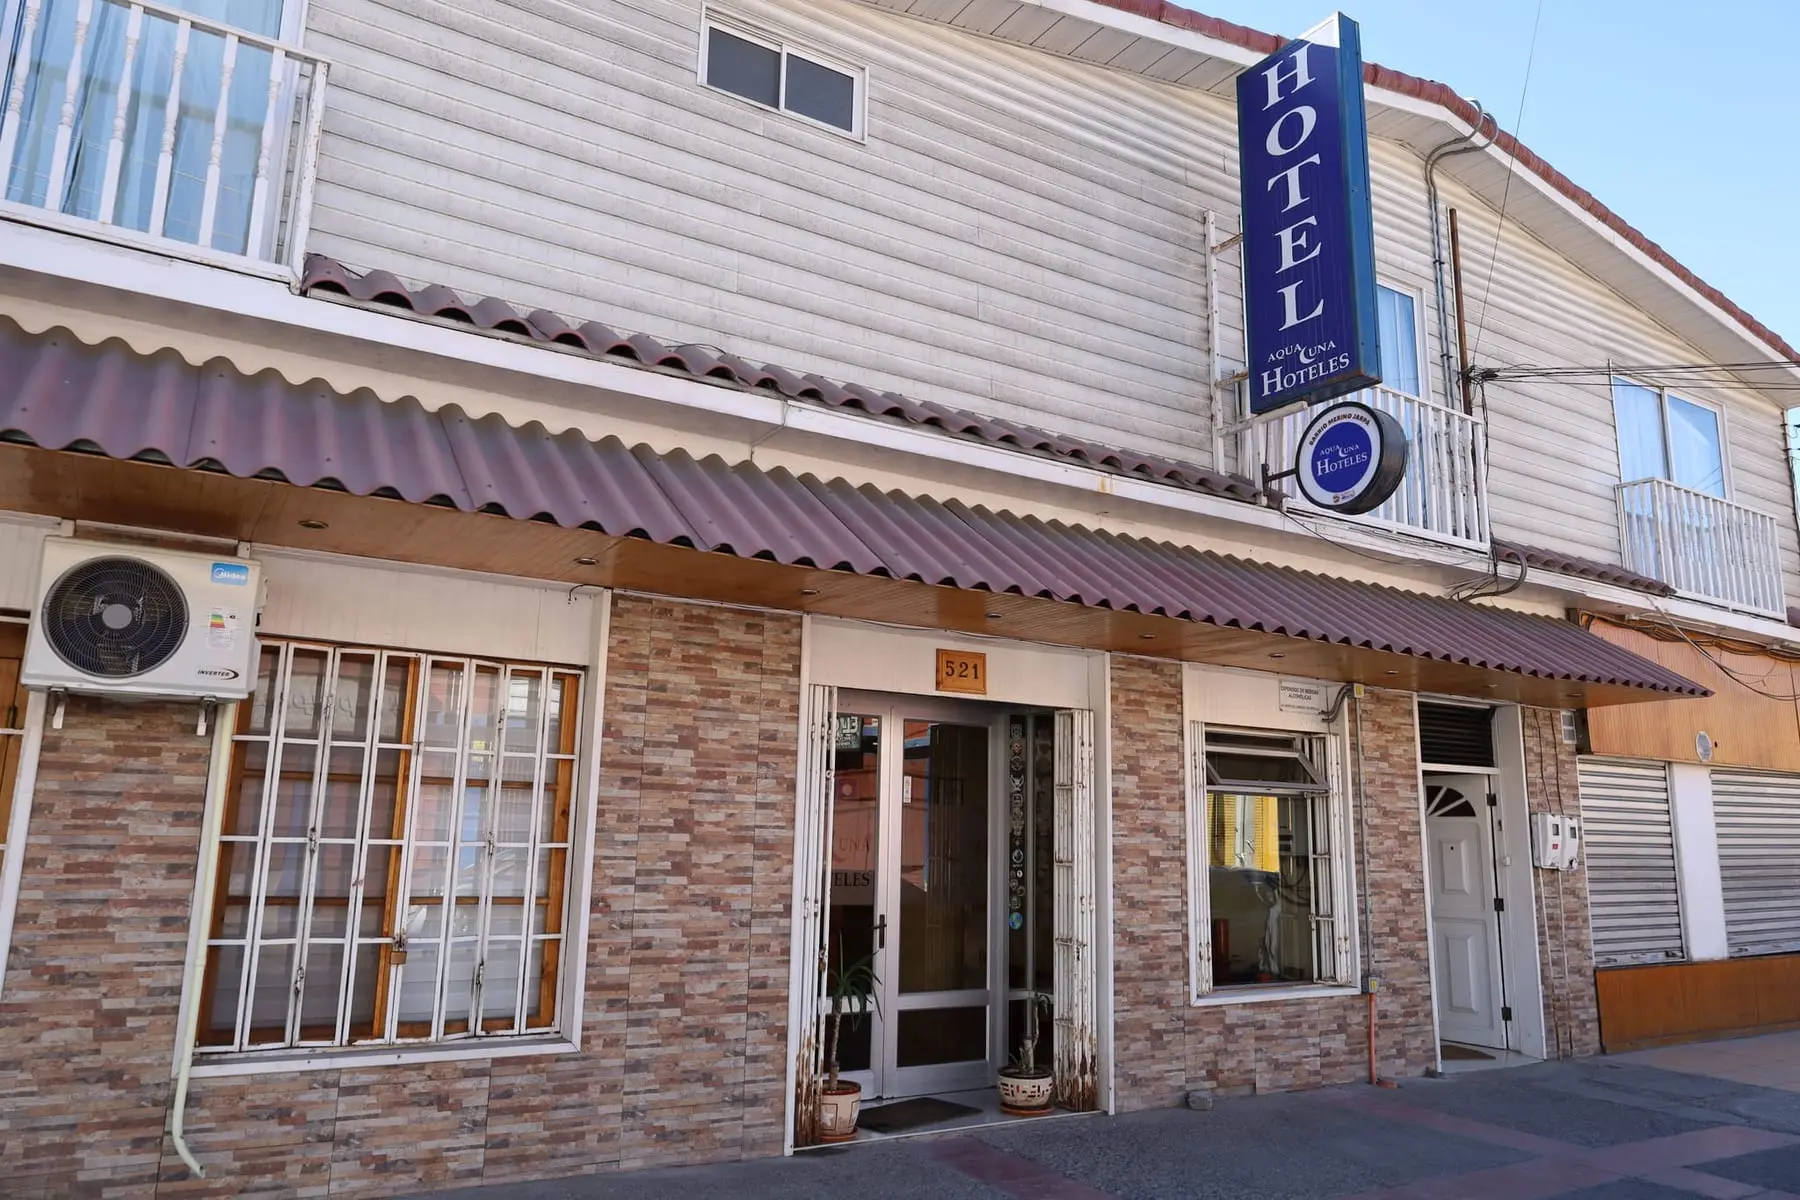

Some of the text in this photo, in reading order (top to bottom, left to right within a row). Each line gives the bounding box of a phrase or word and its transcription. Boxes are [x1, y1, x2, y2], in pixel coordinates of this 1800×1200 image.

[1261, 43, 1324, 331] HOTEL
[1267, 343, 1302, 362] AQUA
[1261, 353, 1350, 397] HOTELES
[1309, 422, 1328, 446] BARRIO
[1328, 413, 1352, 425] MERINO
[1320, 444, 1340, 456] AQUA
[1316, 452, 1368, 476] HOTELES
[214, 567, 246, 580] Midea
[197, 669, 231, 677] INVERTER
[945, 660, 979, 680] 521
[833, 872, 871, 887] ELES
